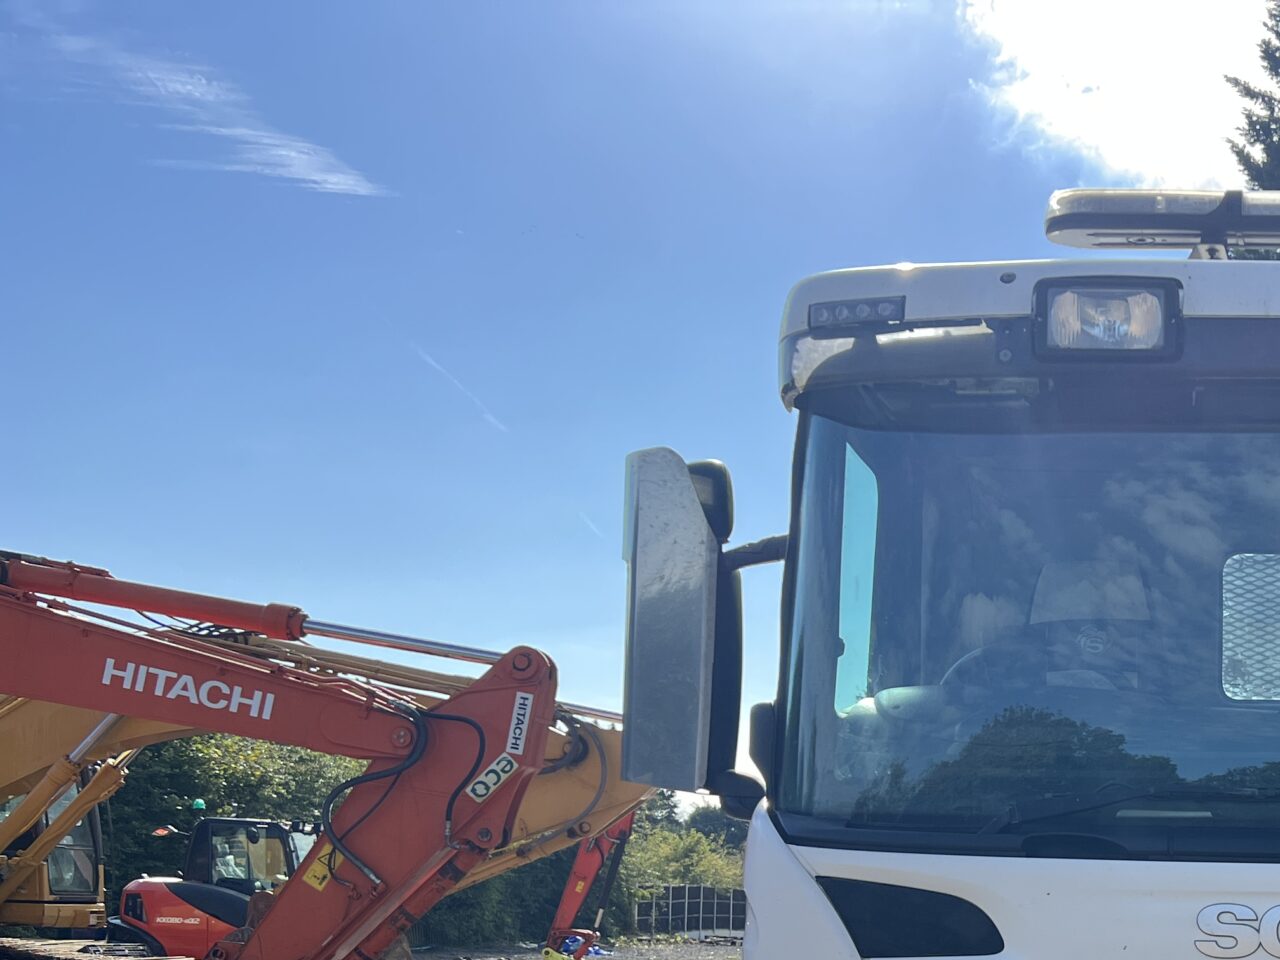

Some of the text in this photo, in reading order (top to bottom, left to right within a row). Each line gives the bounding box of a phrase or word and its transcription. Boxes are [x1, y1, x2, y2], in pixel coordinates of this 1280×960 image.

[102, 657, 275, 721] HITACHI
[510, 695, 530, 751] HITACHI
[470, 756, 514, 798] eco
